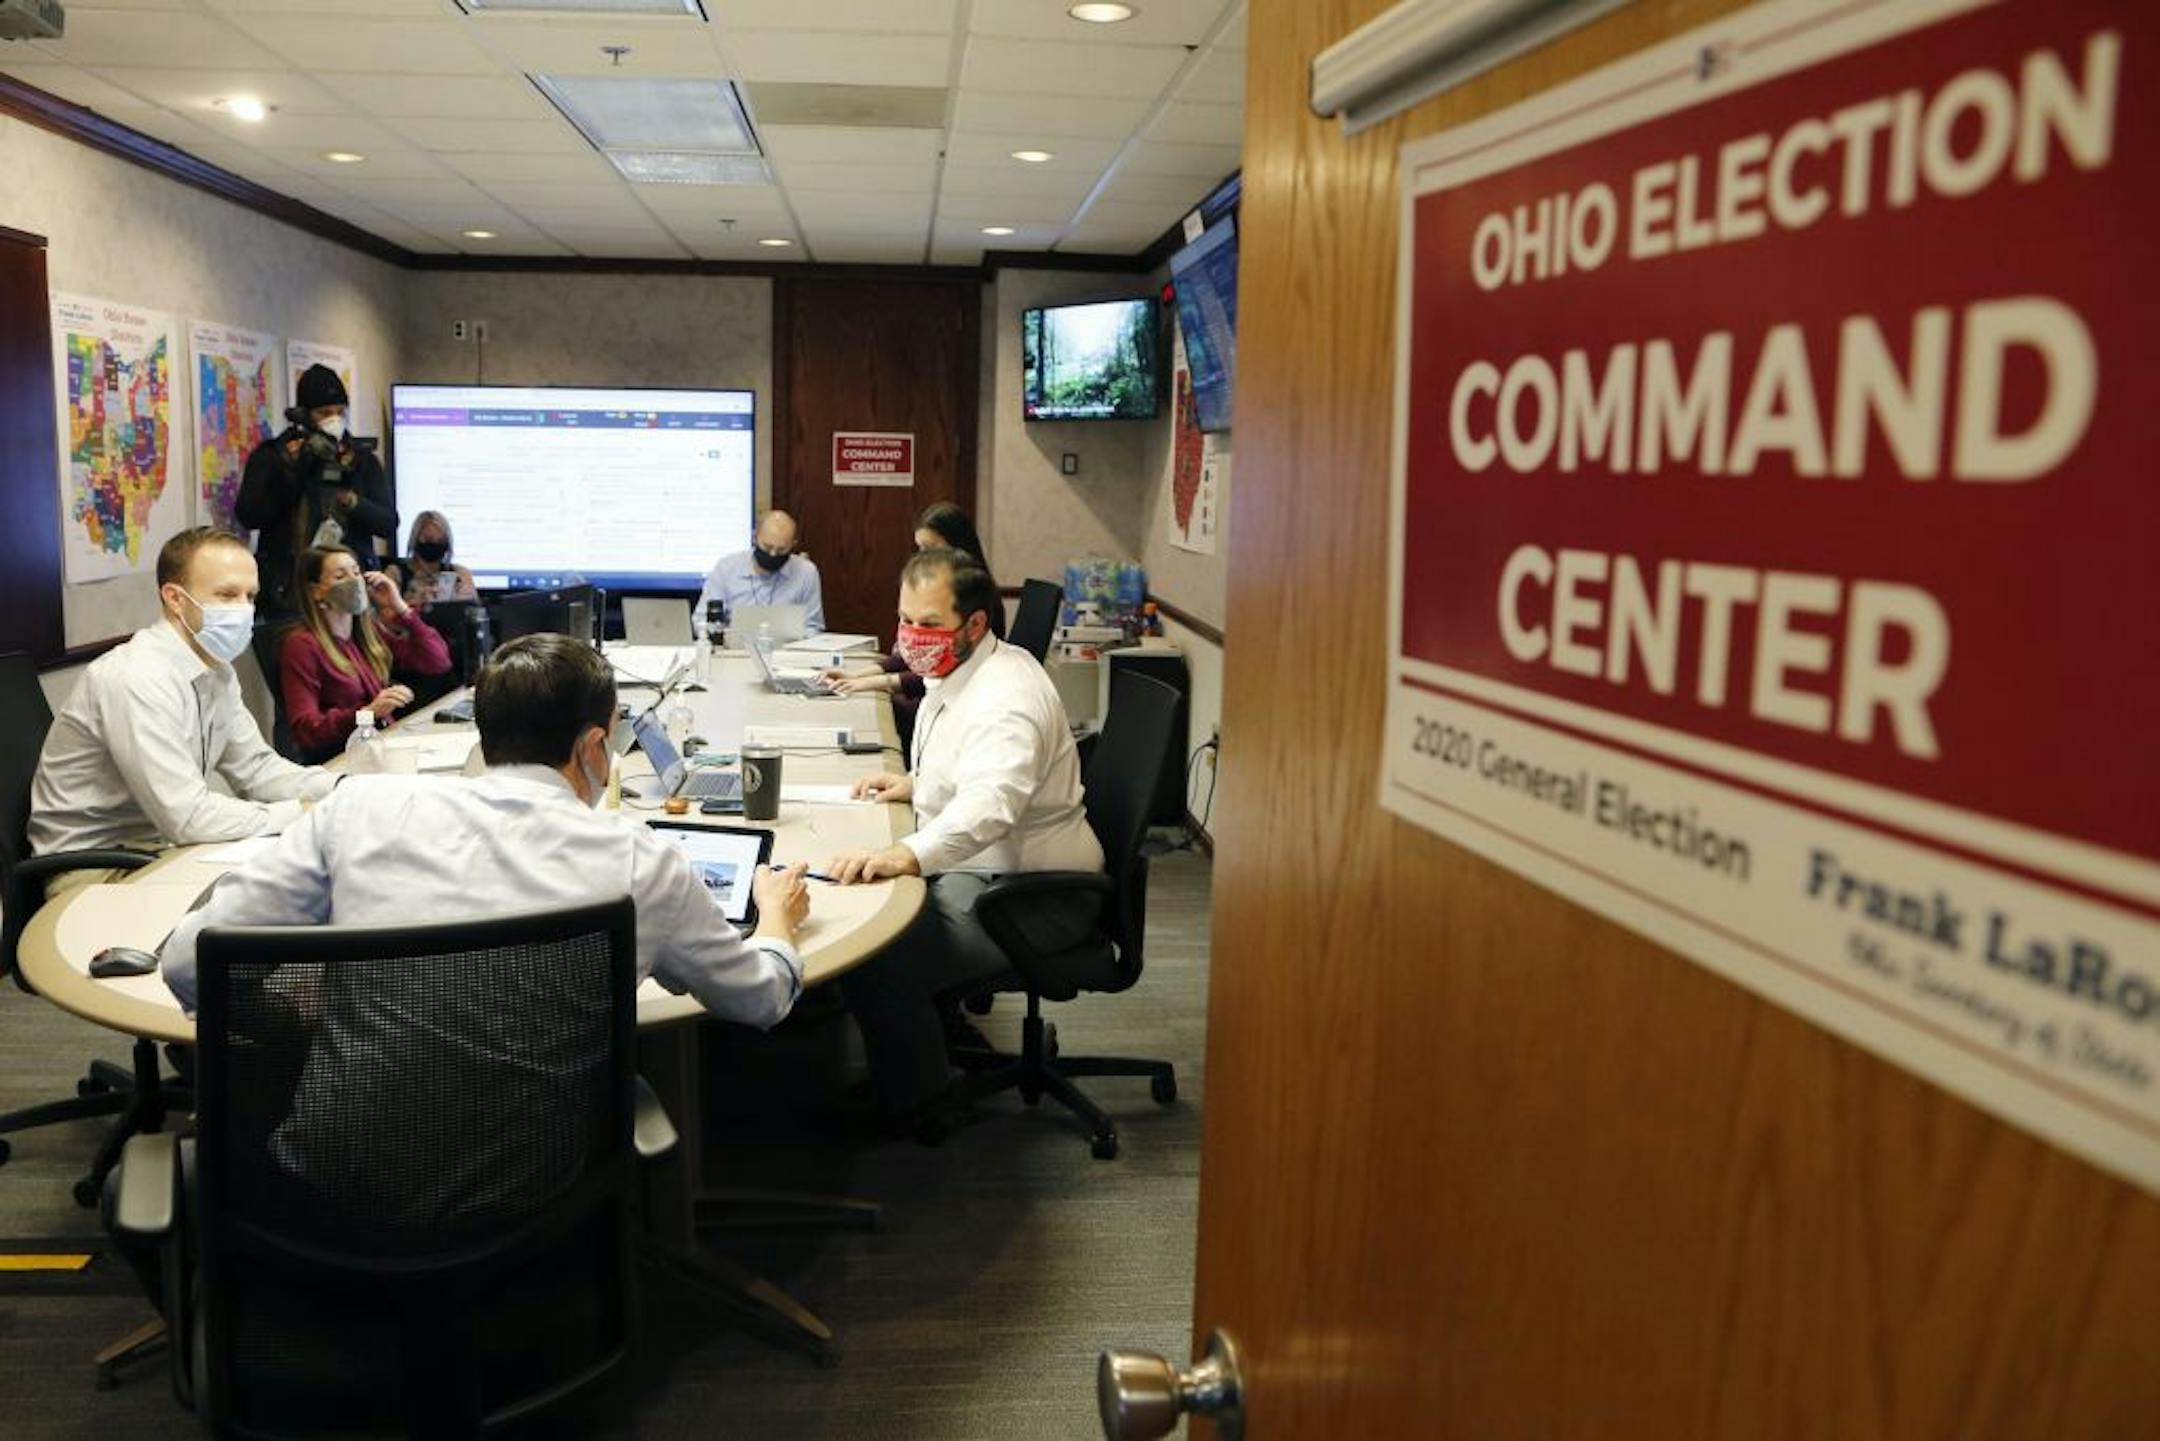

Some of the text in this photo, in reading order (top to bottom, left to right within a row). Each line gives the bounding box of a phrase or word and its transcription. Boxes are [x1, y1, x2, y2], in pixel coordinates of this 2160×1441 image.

[1471, 29, 2122, 291] OHIO ELECTION
[842, 448, 902, 460] COMMAND
[850, 461, 896, 472] CENTER
[1448, 294, 2100, 483] COMMAND
[1498, 544, 1951, 760] CENTER
[1411, 715, 1752, 883] 2020 General Election
[1805, 848, 1963, 952] Frank
[1983, 909, 2160, 1022] LaRo
